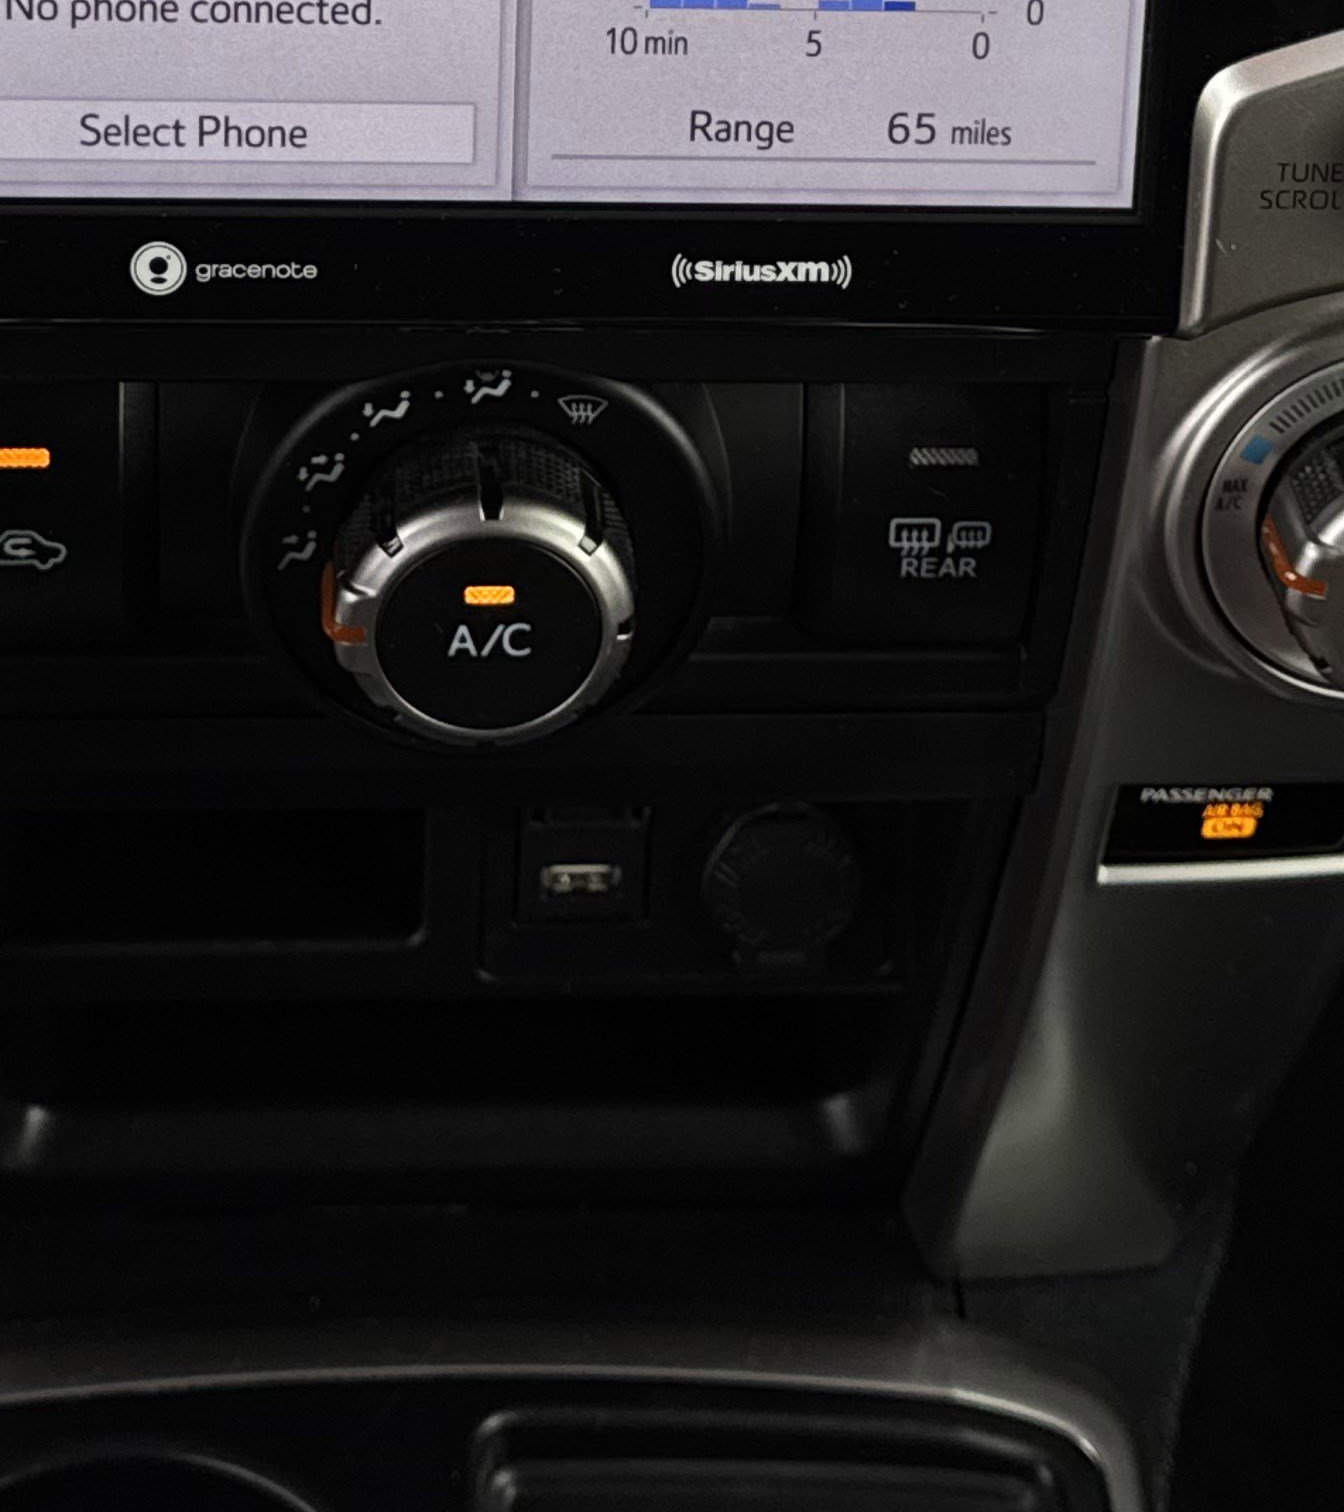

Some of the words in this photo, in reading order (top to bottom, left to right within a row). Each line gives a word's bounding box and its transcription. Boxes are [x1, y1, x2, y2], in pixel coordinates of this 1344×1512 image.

[605, 25, 639, 56] 10
[643, 29, 689, 57] min
[805, 31, 823, 58] 5
[971, 32, 991, 60] 0
[78, 113, 186, 148] Select
[197, 114, 308, 149] Phone
[688, 110, 795, 151] Range
[886, 112, 937, 145] 65
[950, 117, 1013, 147] miles
[1276, 162, 1344, 183] TUNE
[194, 261, 319, 282] gracenote
[900, 556, 978, 580] REAR
[447, 621, 532, 658] A/C
[1140, 787, 1274, 804] PASSENGER
